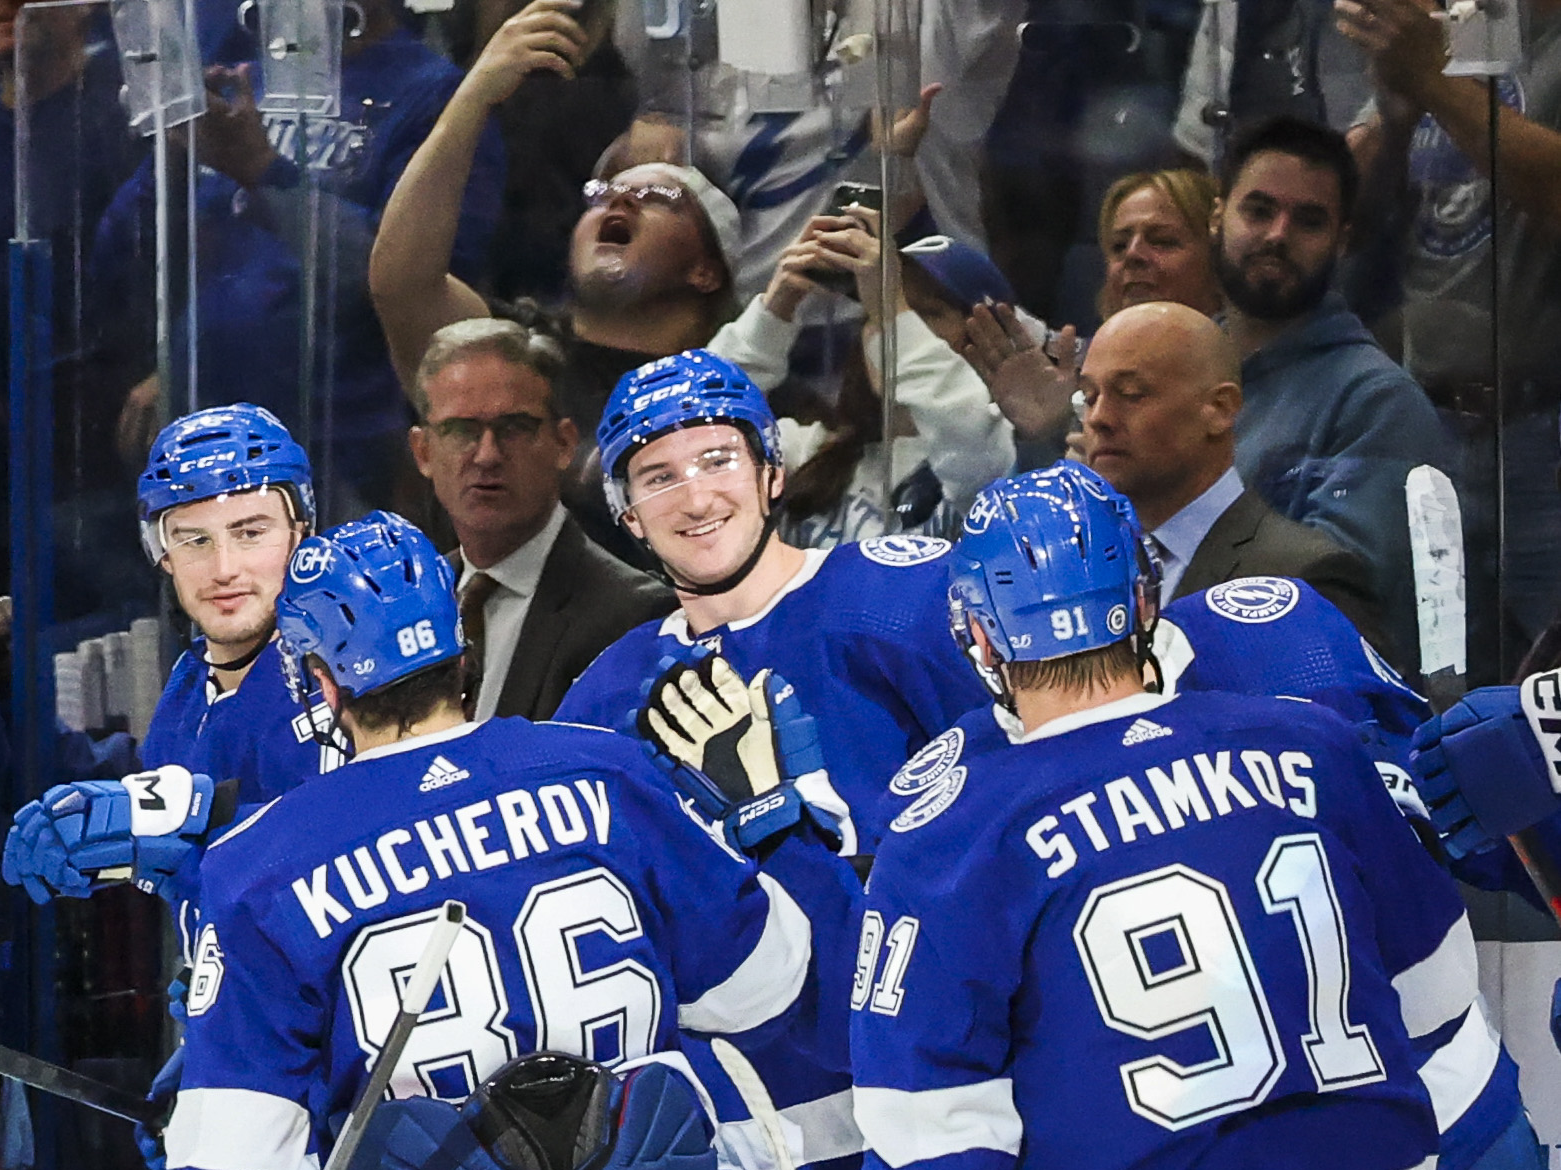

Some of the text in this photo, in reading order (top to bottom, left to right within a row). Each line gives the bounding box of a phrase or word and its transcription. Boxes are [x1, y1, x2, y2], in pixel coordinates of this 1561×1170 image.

[633, 381, 691, 412] CCM
[397, 619, 436, 658] 86
[1051, 606, 1089, 641] 91
[1122, 724, 1174, 747] adidas
[419, 768, 471, 793] adidas
[1025, 750, 1317, 879] STAMKOS
[291, 779, 611, 940] KUCHEROV
[342, 866, 662, 1104] 86
[850, 909, 920, 1017] 91
[1073, 832, 1387, 1131] 91
